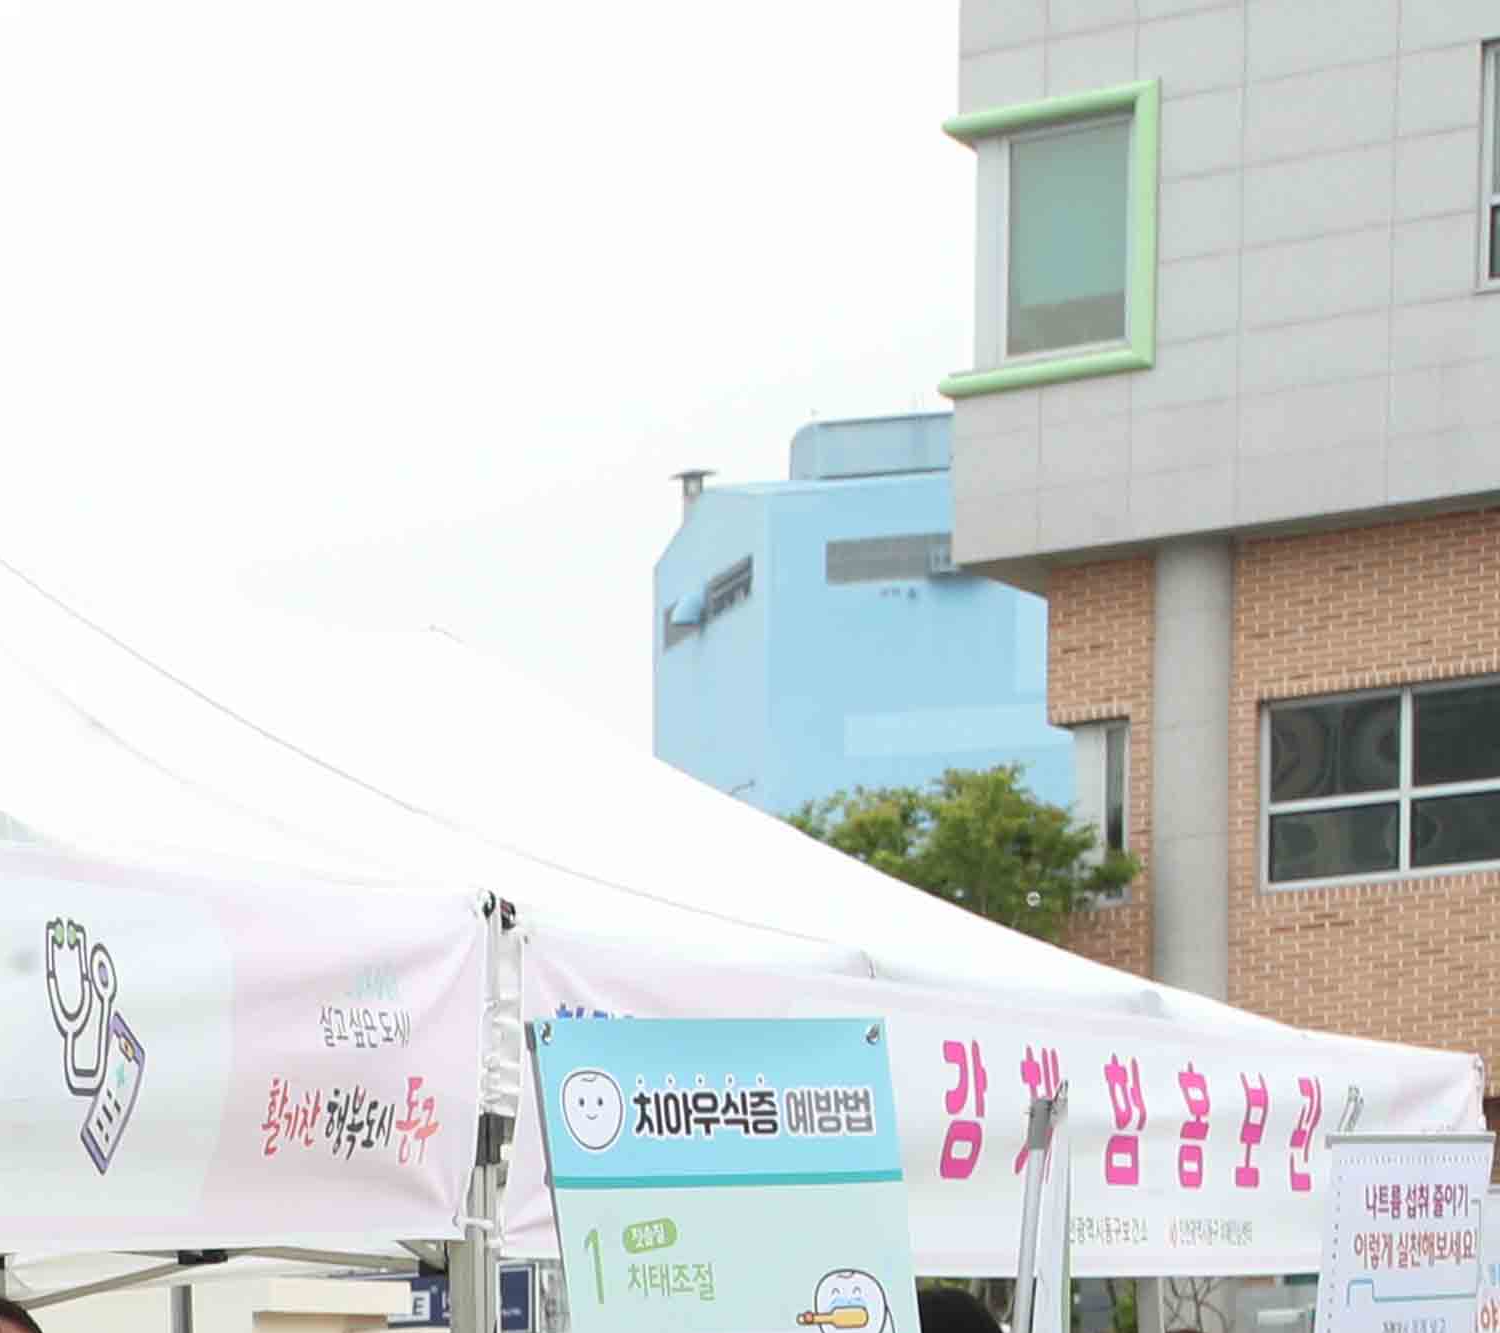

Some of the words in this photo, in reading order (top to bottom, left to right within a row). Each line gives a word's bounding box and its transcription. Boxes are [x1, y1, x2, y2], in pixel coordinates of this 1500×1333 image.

[261, 1077, 321, 1156] 활기찬
[633, 1088, 779, 1137] 치아우식증
[785, 1087, 875, 1136] 예방법
[1364, 1184, 1401, 1220] 나트륨
[1405, 1184, 1430, 1219] 섭취
[1432, 1183, 1469, 1219] 줄이기
[584, 1227, 605, 1304] 1
[1354, 1231, 1394, 1270] 이렇게
[627, 1260, 717, 1302] 치태조절
